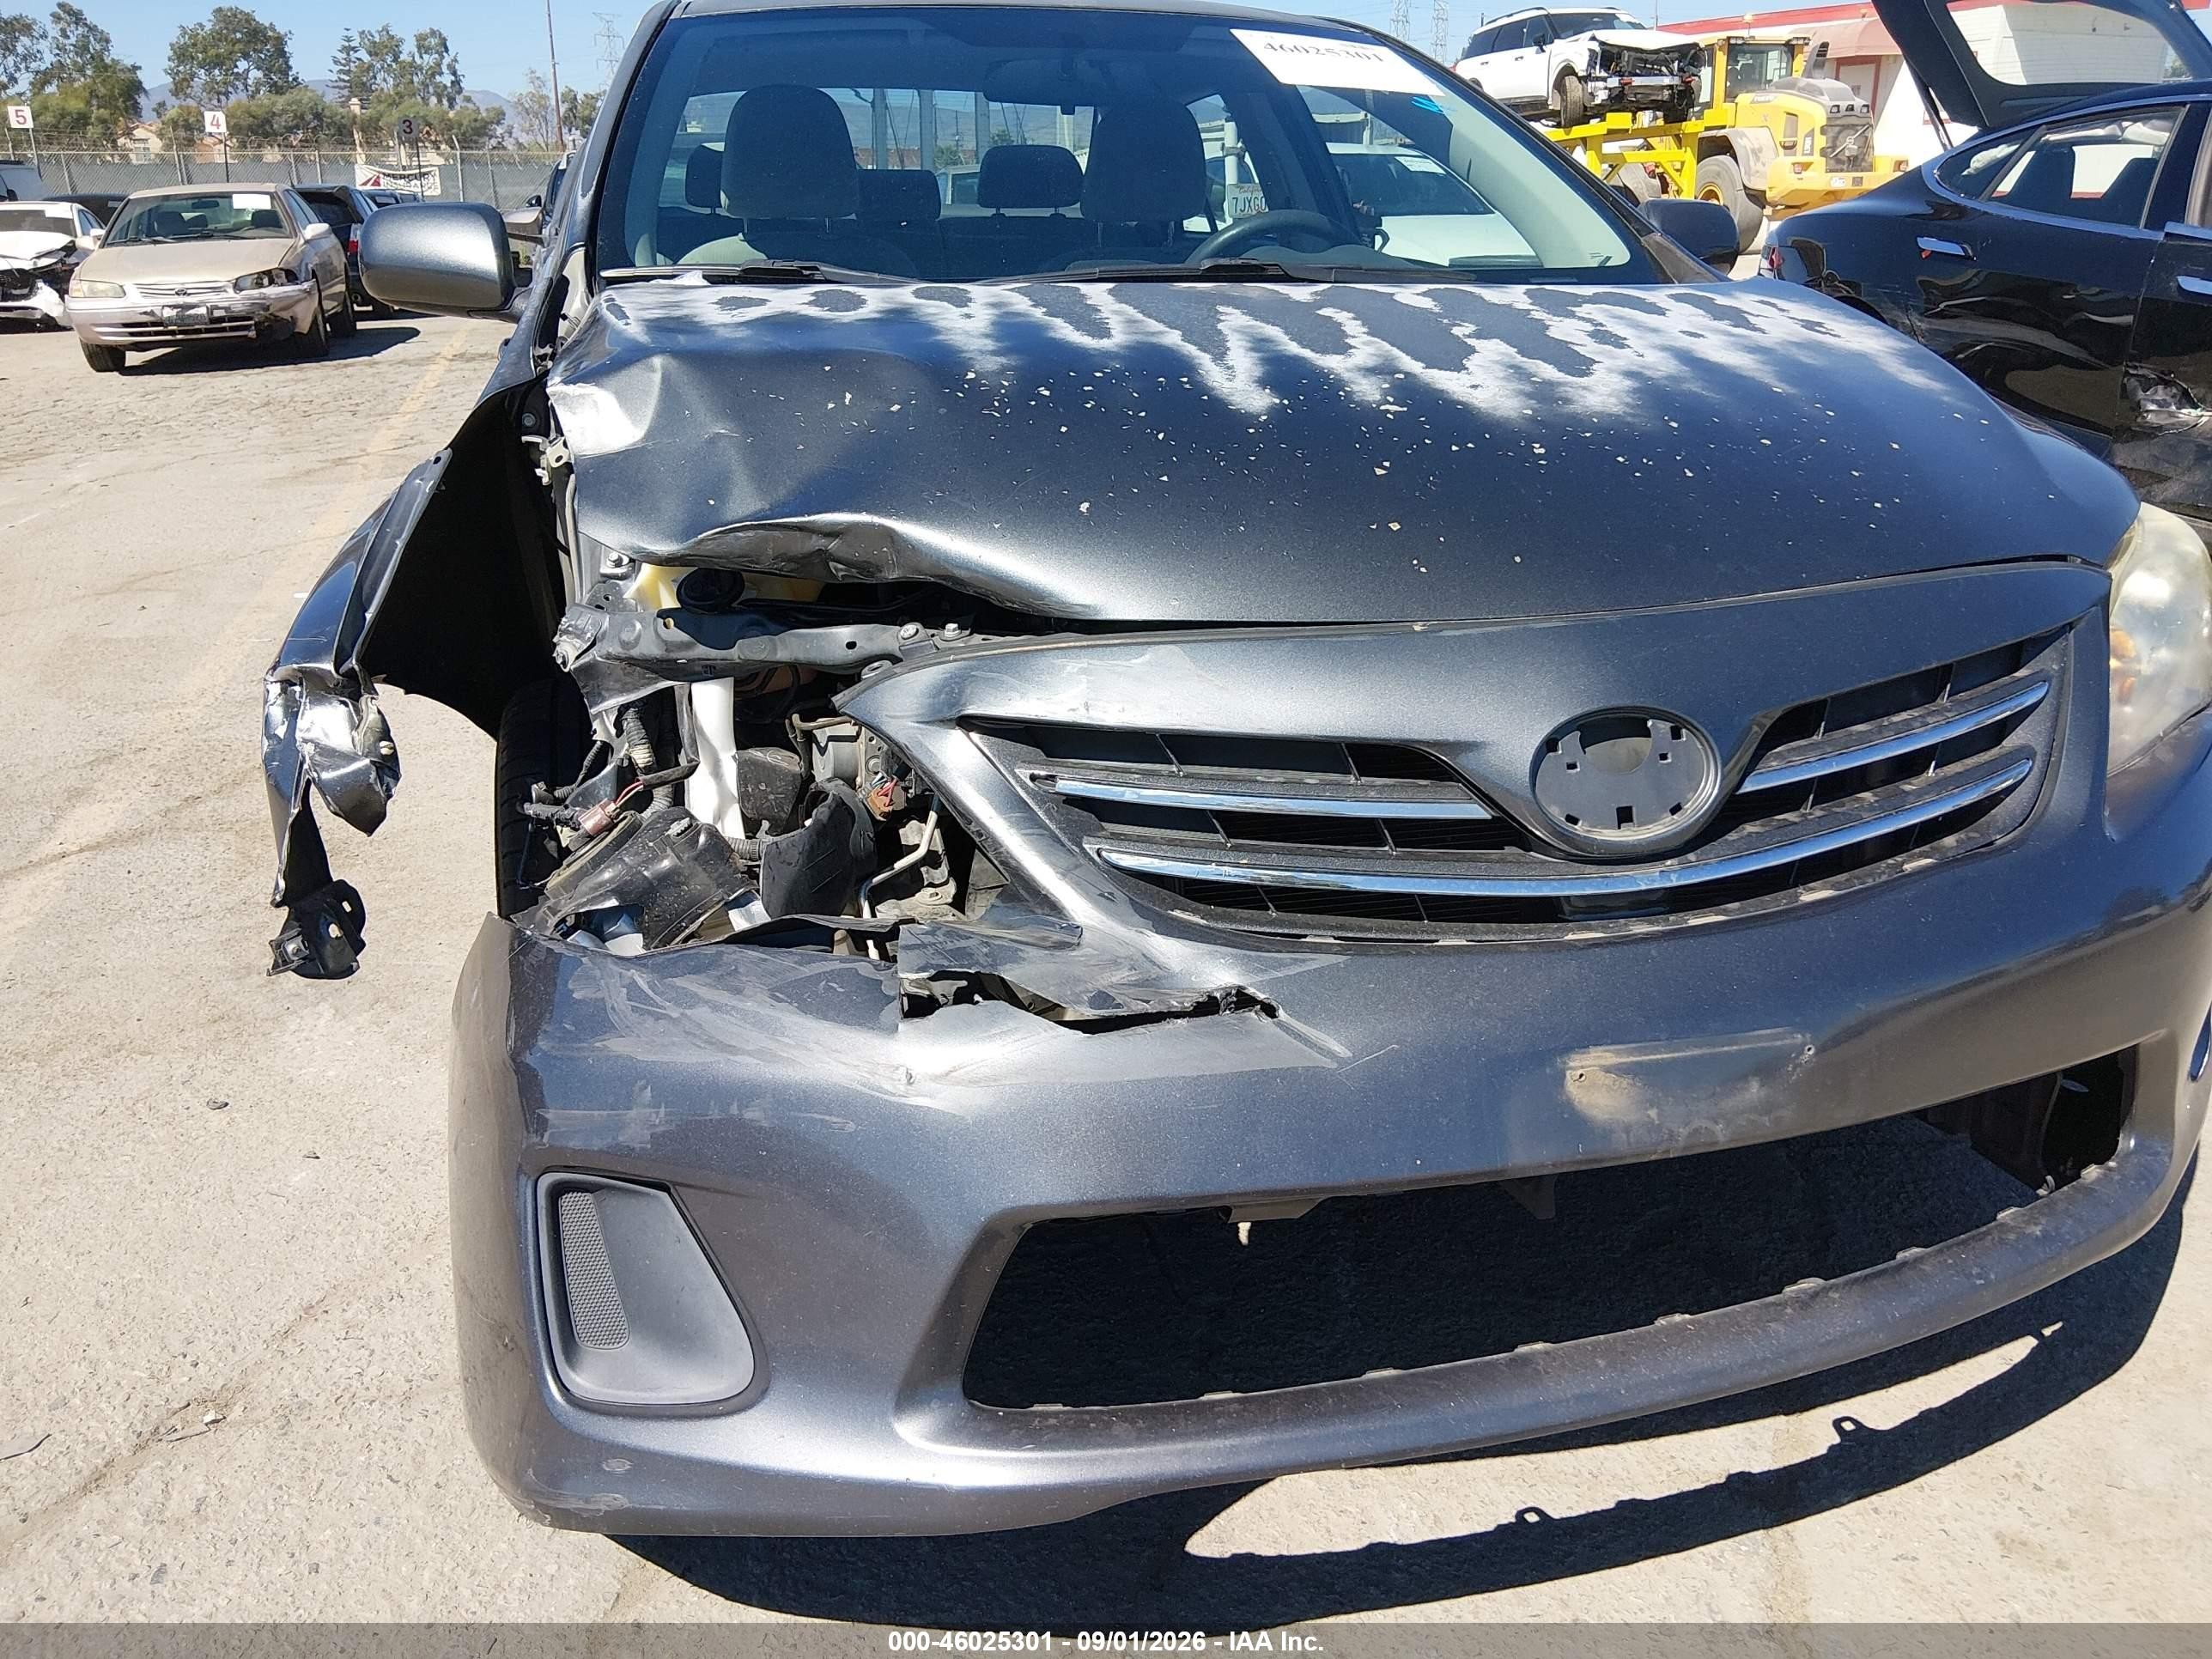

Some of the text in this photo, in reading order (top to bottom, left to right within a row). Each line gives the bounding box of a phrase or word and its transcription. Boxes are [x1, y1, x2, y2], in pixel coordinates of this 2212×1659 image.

[1263, 43, 1383, 62] 46025301
[15, 109, 27, 125] 5
[210, 114, 221, 129] 4
[402, 119, 413, 135] 3
